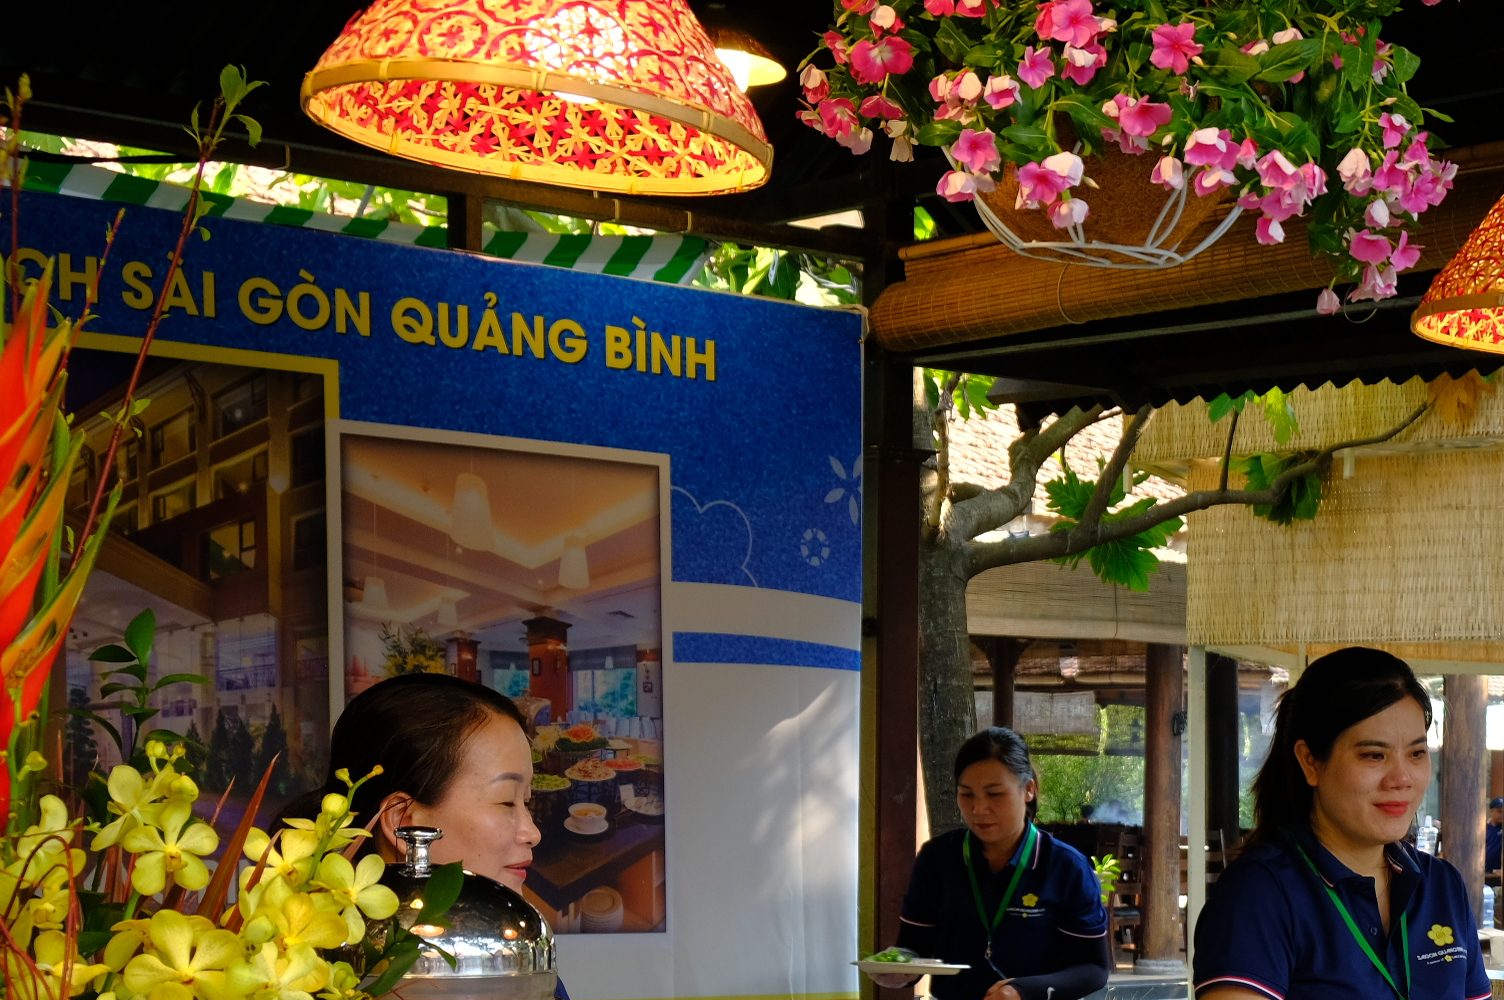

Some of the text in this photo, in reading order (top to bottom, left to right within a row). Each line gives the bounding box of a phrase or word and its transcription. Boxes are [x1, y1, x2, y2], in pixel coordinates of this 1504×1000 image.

[122, 251, 216, 318] SÀI
[238, 269, 371, 337] GÒN
[391, 292, 589, 364] QUẢNG
[605, 316, 716, 381] BÌNH
